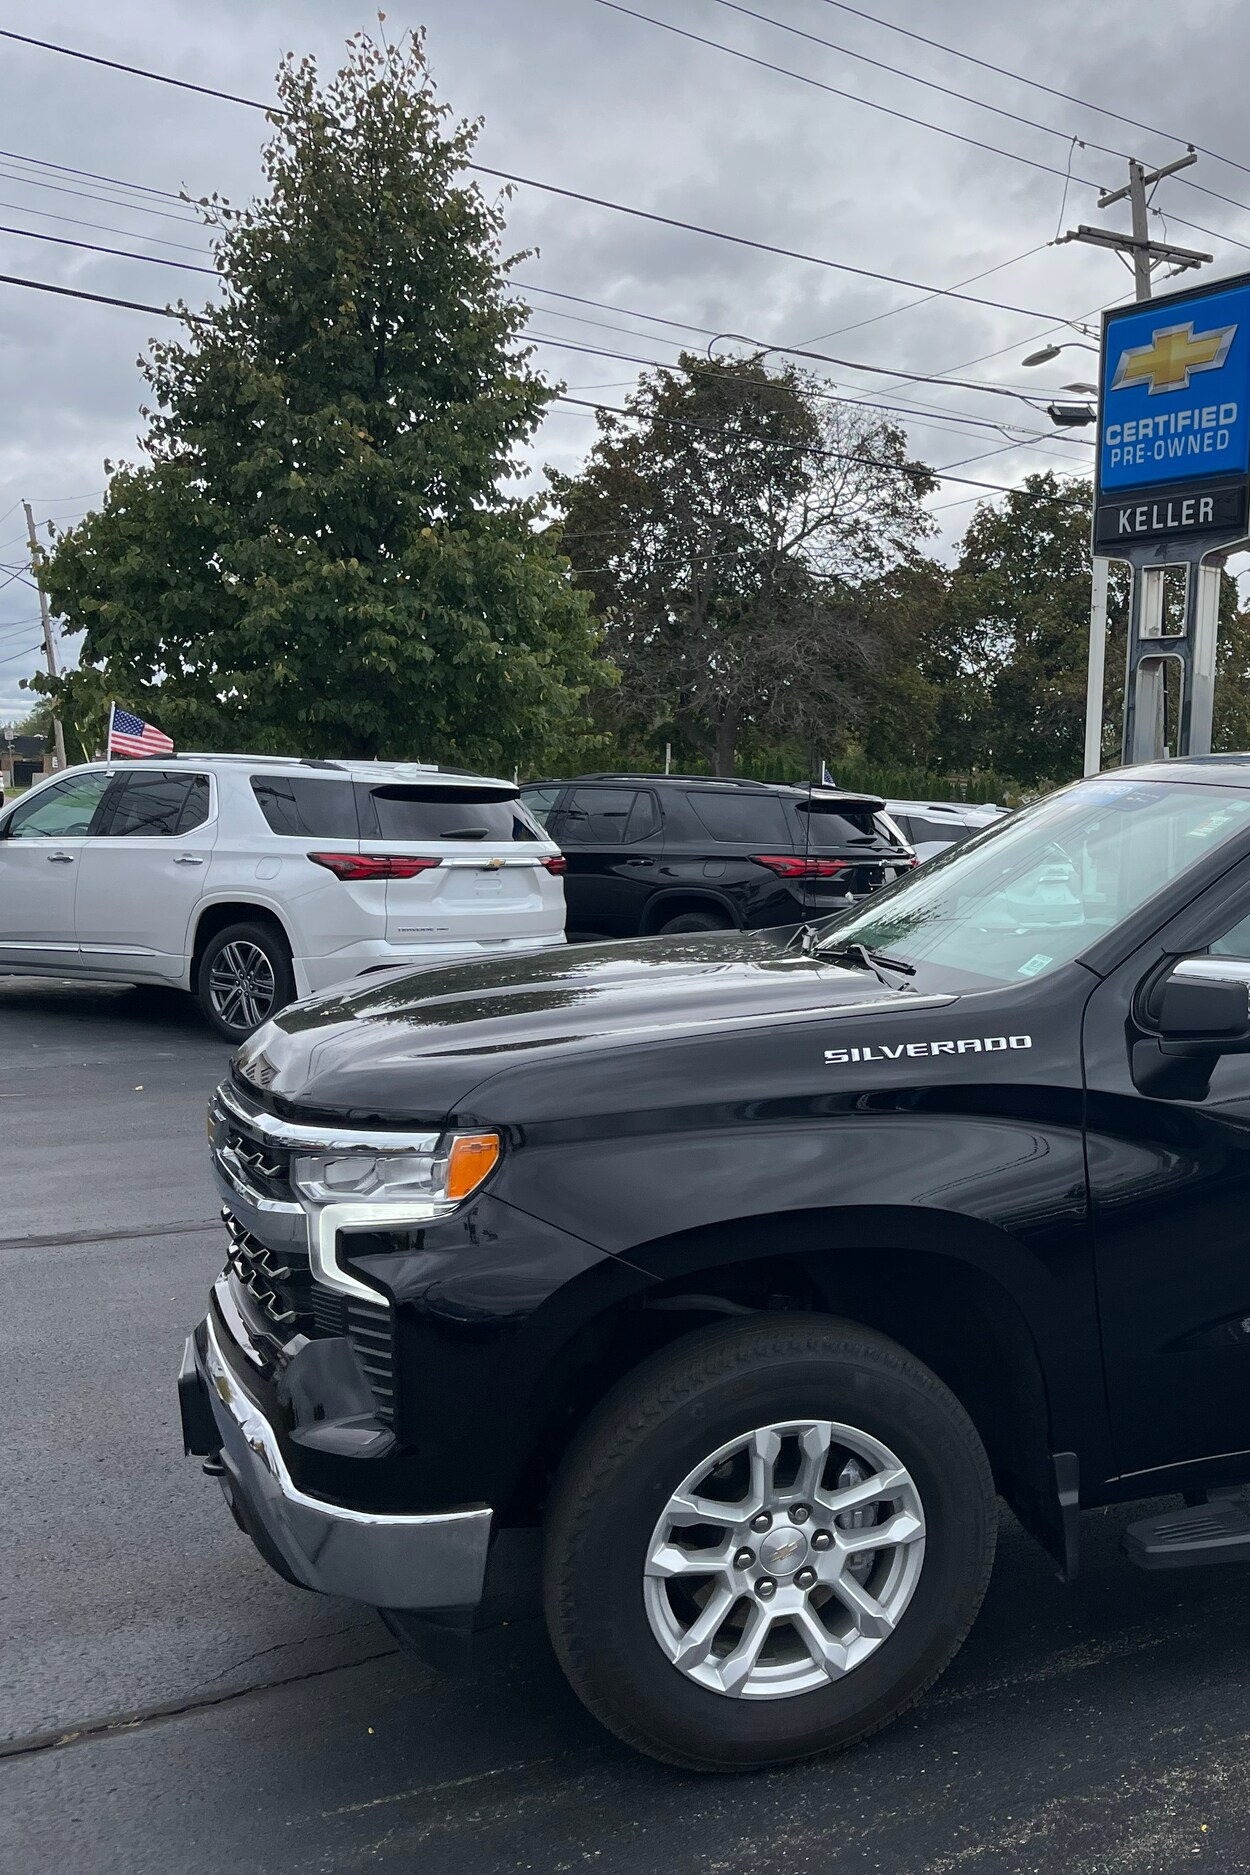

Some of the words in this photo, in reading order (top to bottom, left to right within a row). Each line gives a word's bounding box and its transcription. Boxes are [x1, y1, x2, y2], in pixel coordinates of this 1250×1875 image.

[1106, 402, 1238, 446] CERTIFIED
[1110, 429, 1229, 468] PRE-OWNED
[1118, 497, 1214, 534] KELLER
[824, 1035, 1032, 1065] SILVERADO
